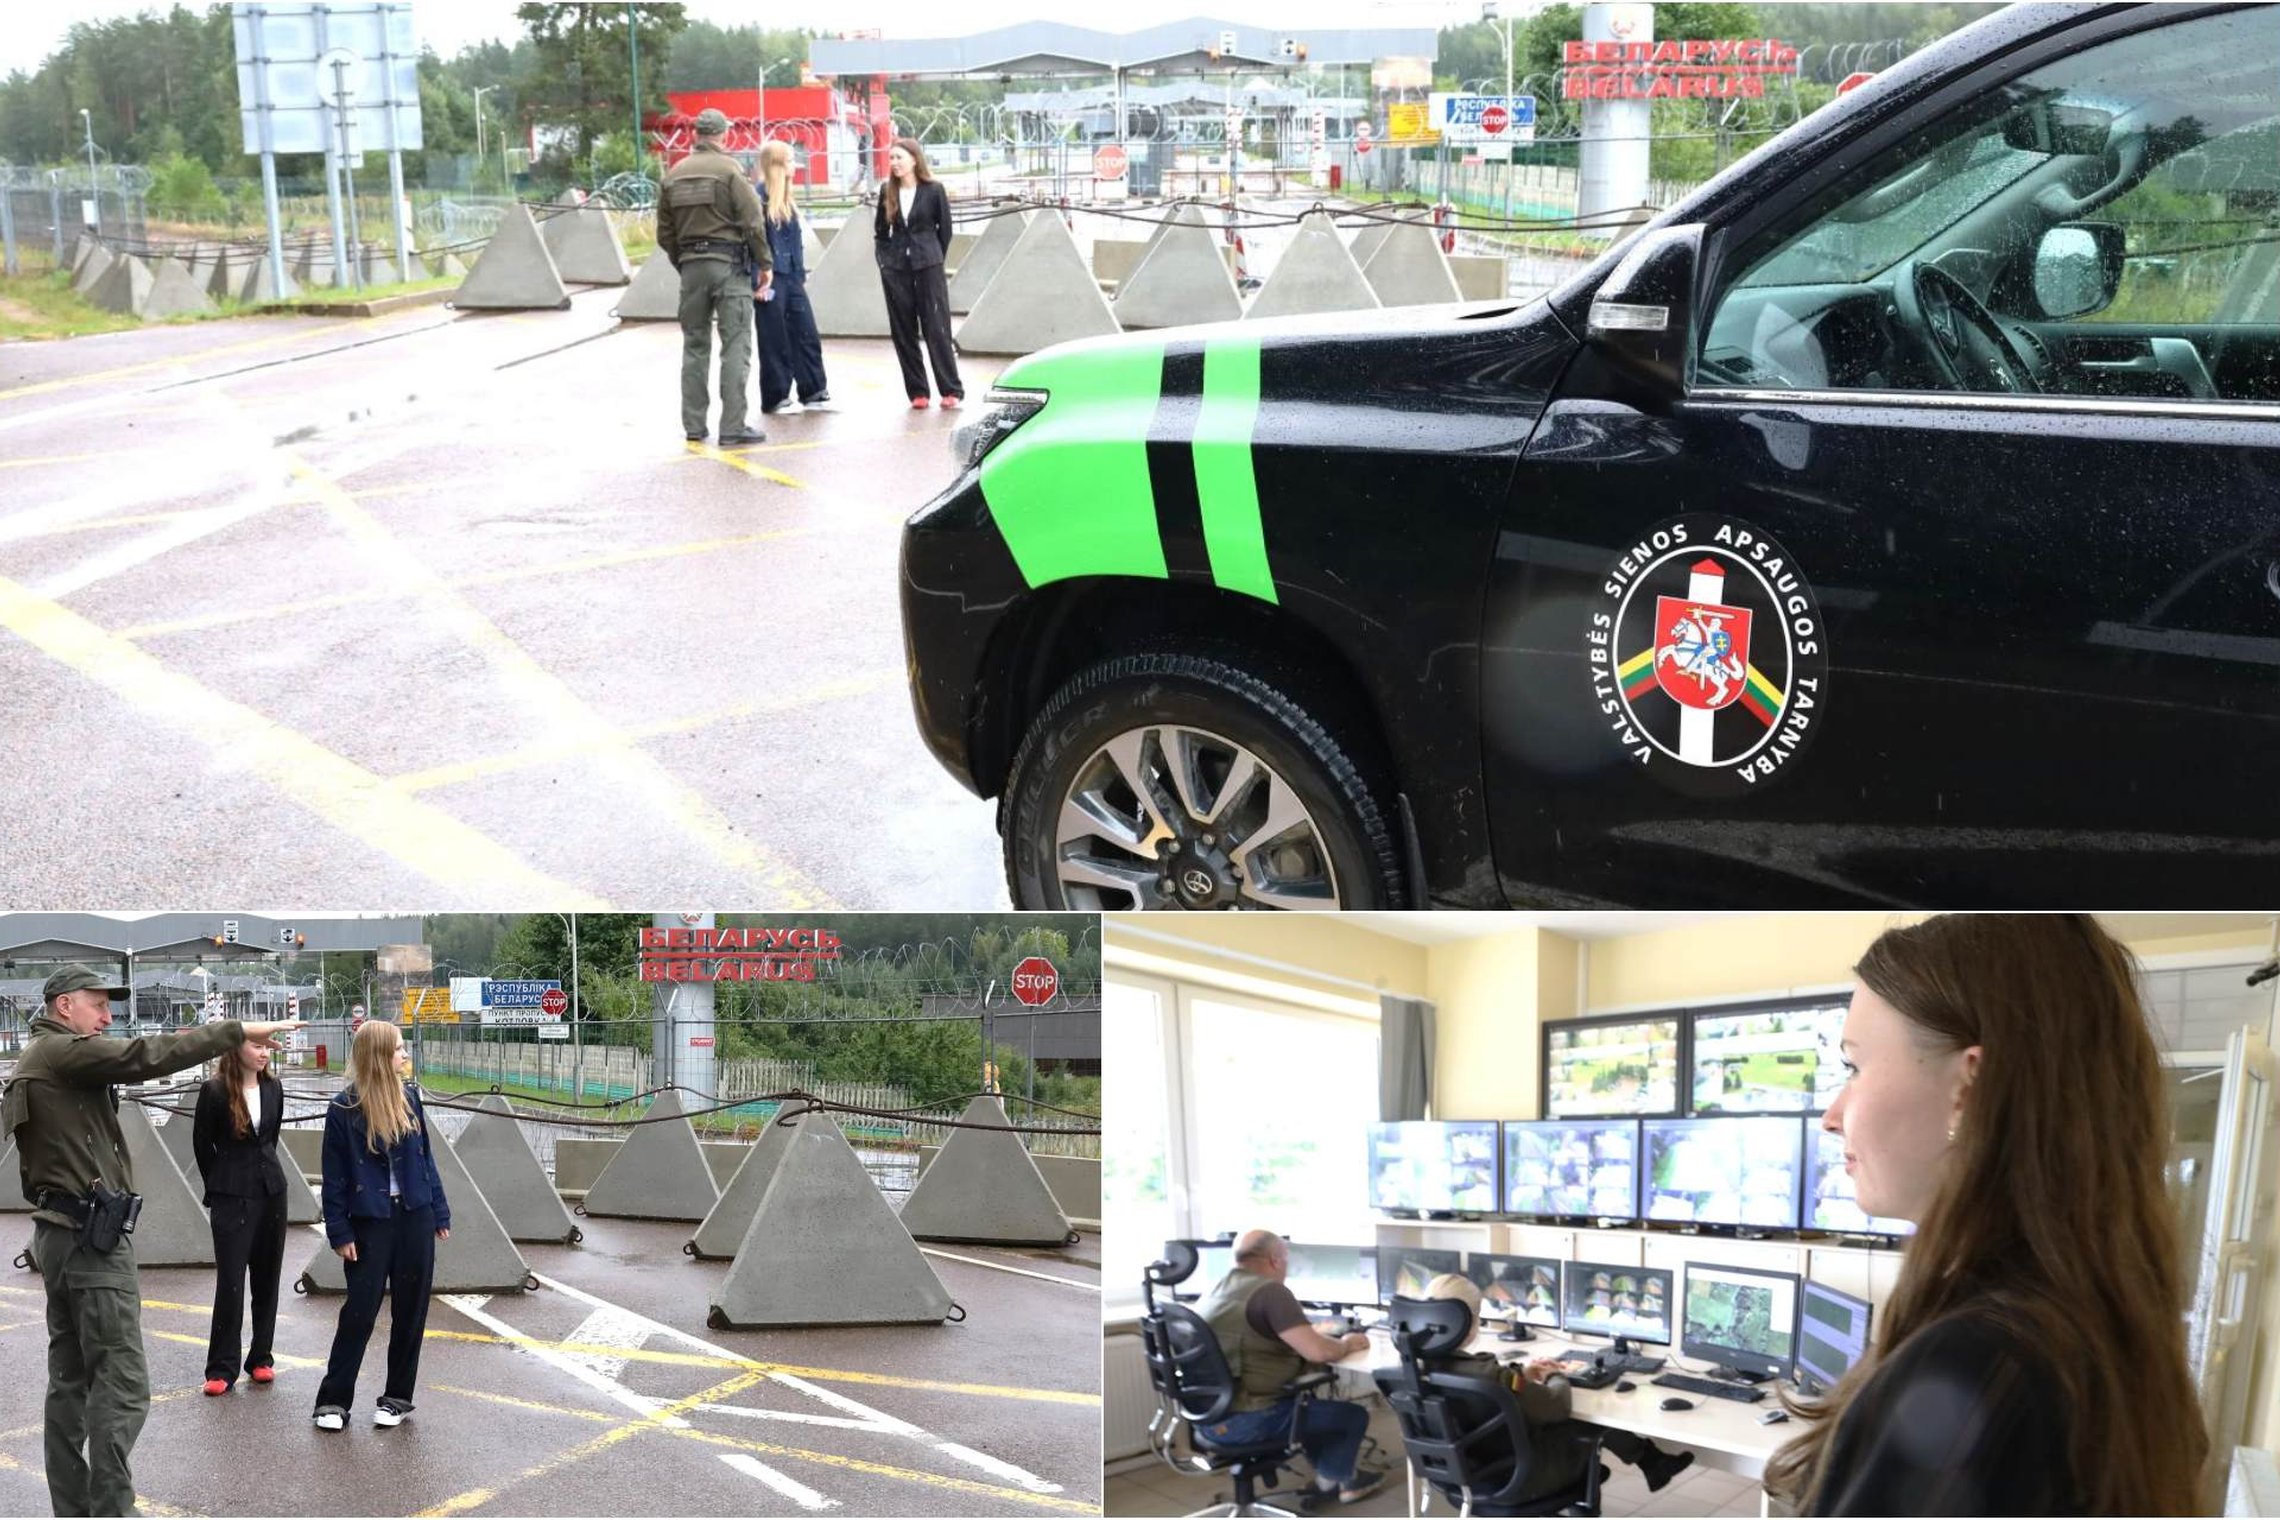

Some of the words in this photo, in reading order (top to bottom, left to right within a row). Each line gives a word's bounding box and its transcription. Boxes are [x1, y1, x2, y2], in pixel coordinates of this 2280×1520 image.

[1564, 40, 1797, 62] БЕЛАРУСЬ
[1563, 76, 1764, 98] BELARUS
[1482, 115, 1507, 125] STOP
[1604, 523, 1688, 599] SIENOS
[1714, 524, 1818, 656] APSAUGOS
[1586, 612, 1652, 765] VALSTYBĖS
[1736, 677, 1818, 784] TARNYBA
[639, 928, 842, 947] БЕЛАРУСЬ
[639, 962, 816, 981] BELARUS
[489, 983, 552, 993] РЭСПУБЛІКА
[1016, 973, 1055, 990] STOP
[494, 995, 541, 1004] БЕЛАРУС
[542, 999, 566, 1007] STOP
